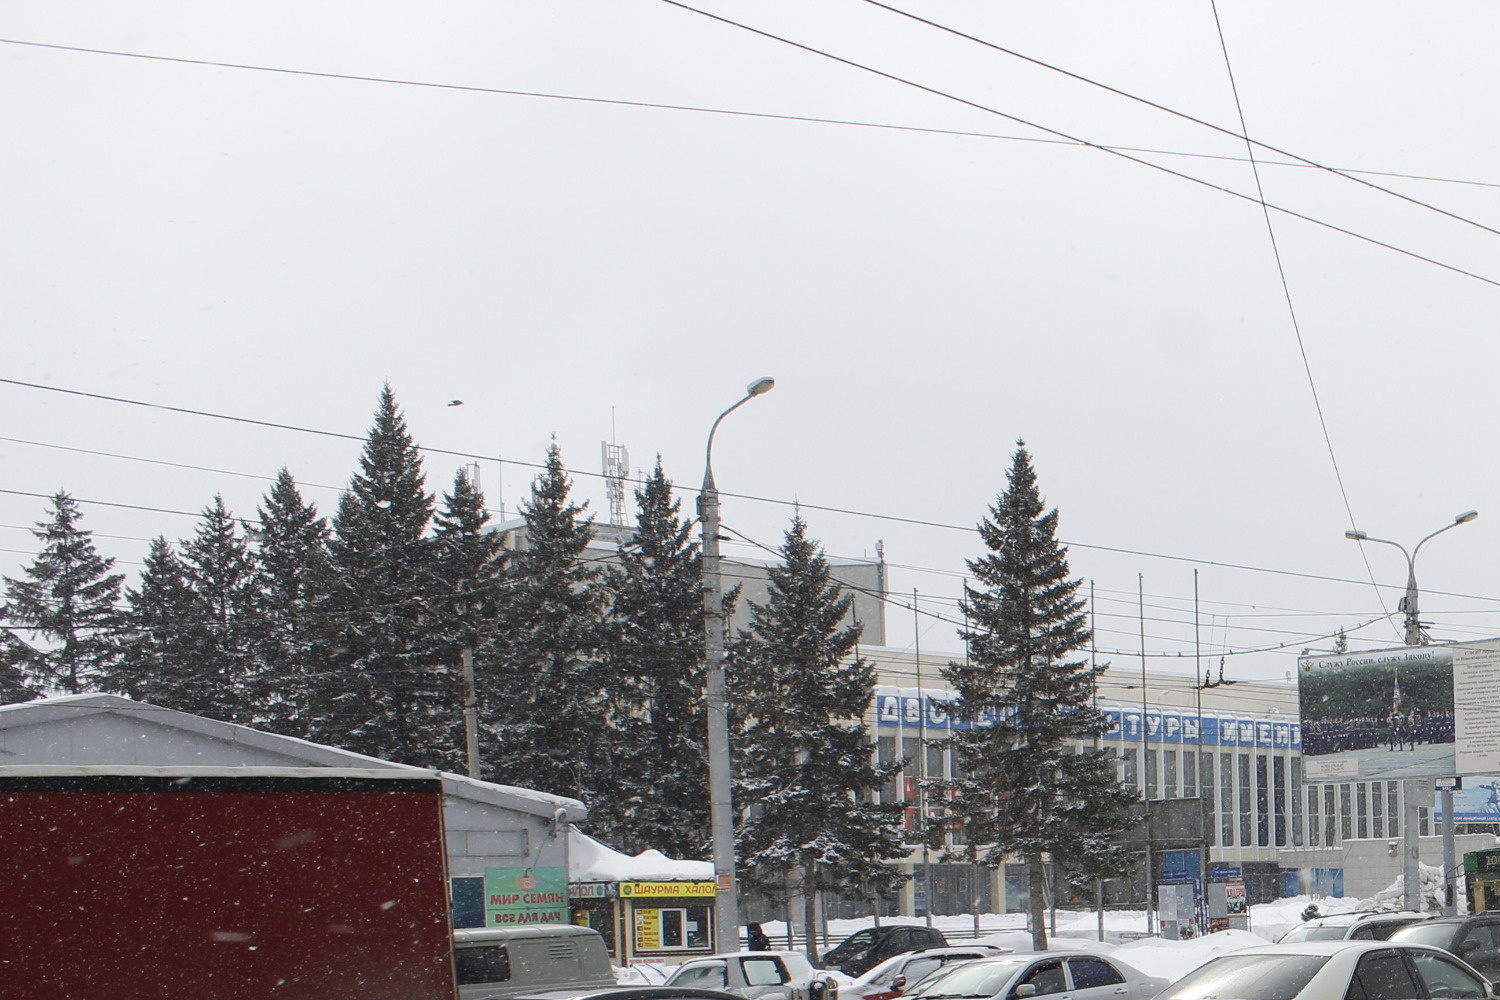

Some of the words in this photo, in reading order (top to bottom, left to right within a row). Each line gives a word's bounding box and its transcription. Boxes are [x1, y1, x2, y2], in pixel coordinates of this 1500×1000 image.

[1318, 658, 1344, 669] Служу
[1377, 655, 1401, 665] служу
[1403, 650, 1435, 662] Закону!
[1485, 855, 1498, 866] 10
[634, 885, 680, 895] ШАУРМА
[490, 894, 520, 905] МИР
[523, 893, 564, 904] СЕМЯН
[495, 913, 516, 924] ВСЕ
[517, 912, 539, 923] ДЛЯ
[540, 911, 561, 922] ДАЧ
